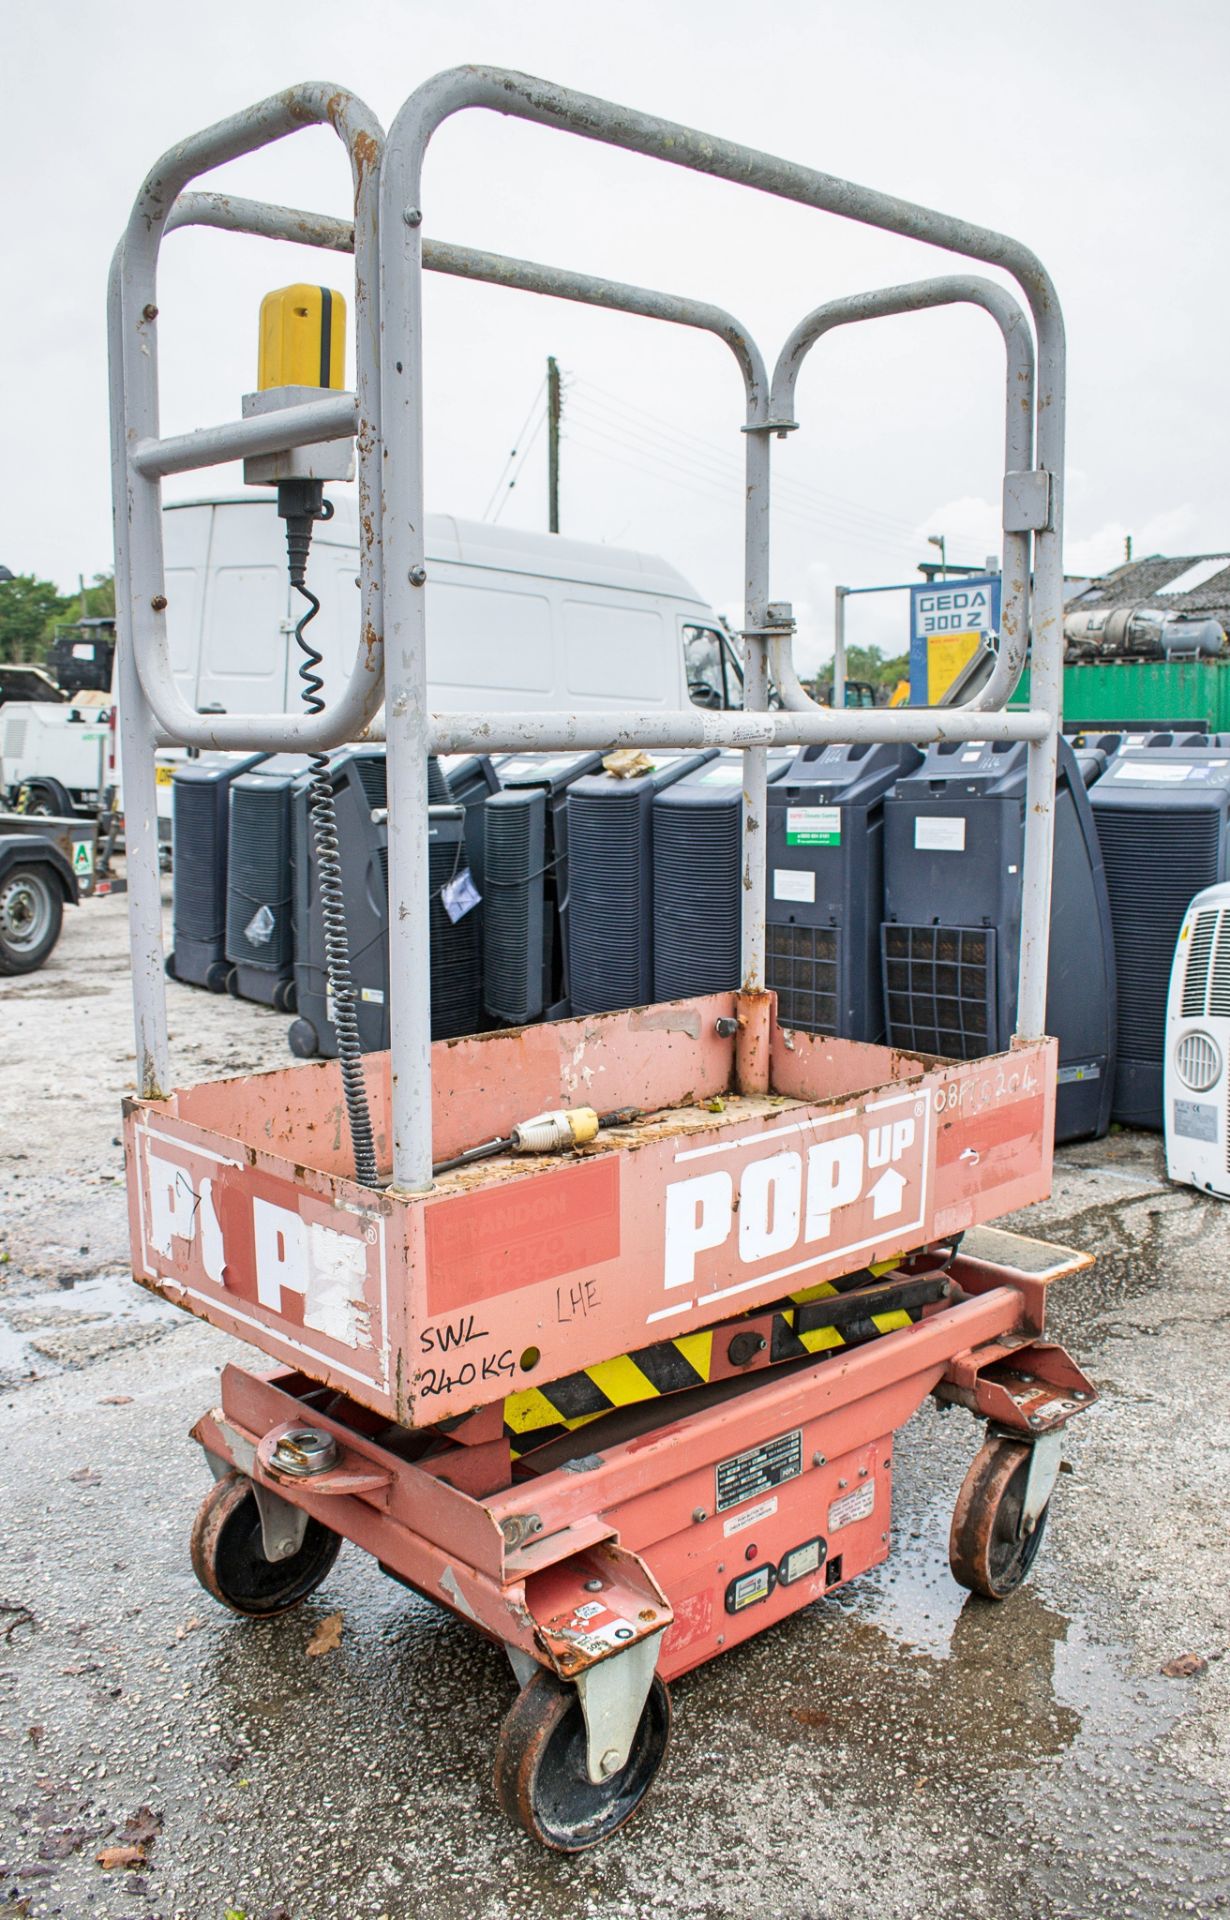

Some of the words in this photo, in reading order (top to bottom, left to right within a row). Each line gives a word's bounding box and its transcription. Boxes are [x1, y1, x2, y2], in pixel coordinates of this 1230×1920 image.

[919, 591, 986, 613] GEDA
[924, 614, 962, 632] 300
[966, 612, 982, 627] Z
[664, 1133, 864, 1290] POP
[868, 1118, 916, 1170] UP
[419, 1315, 490, 1353] SWL
